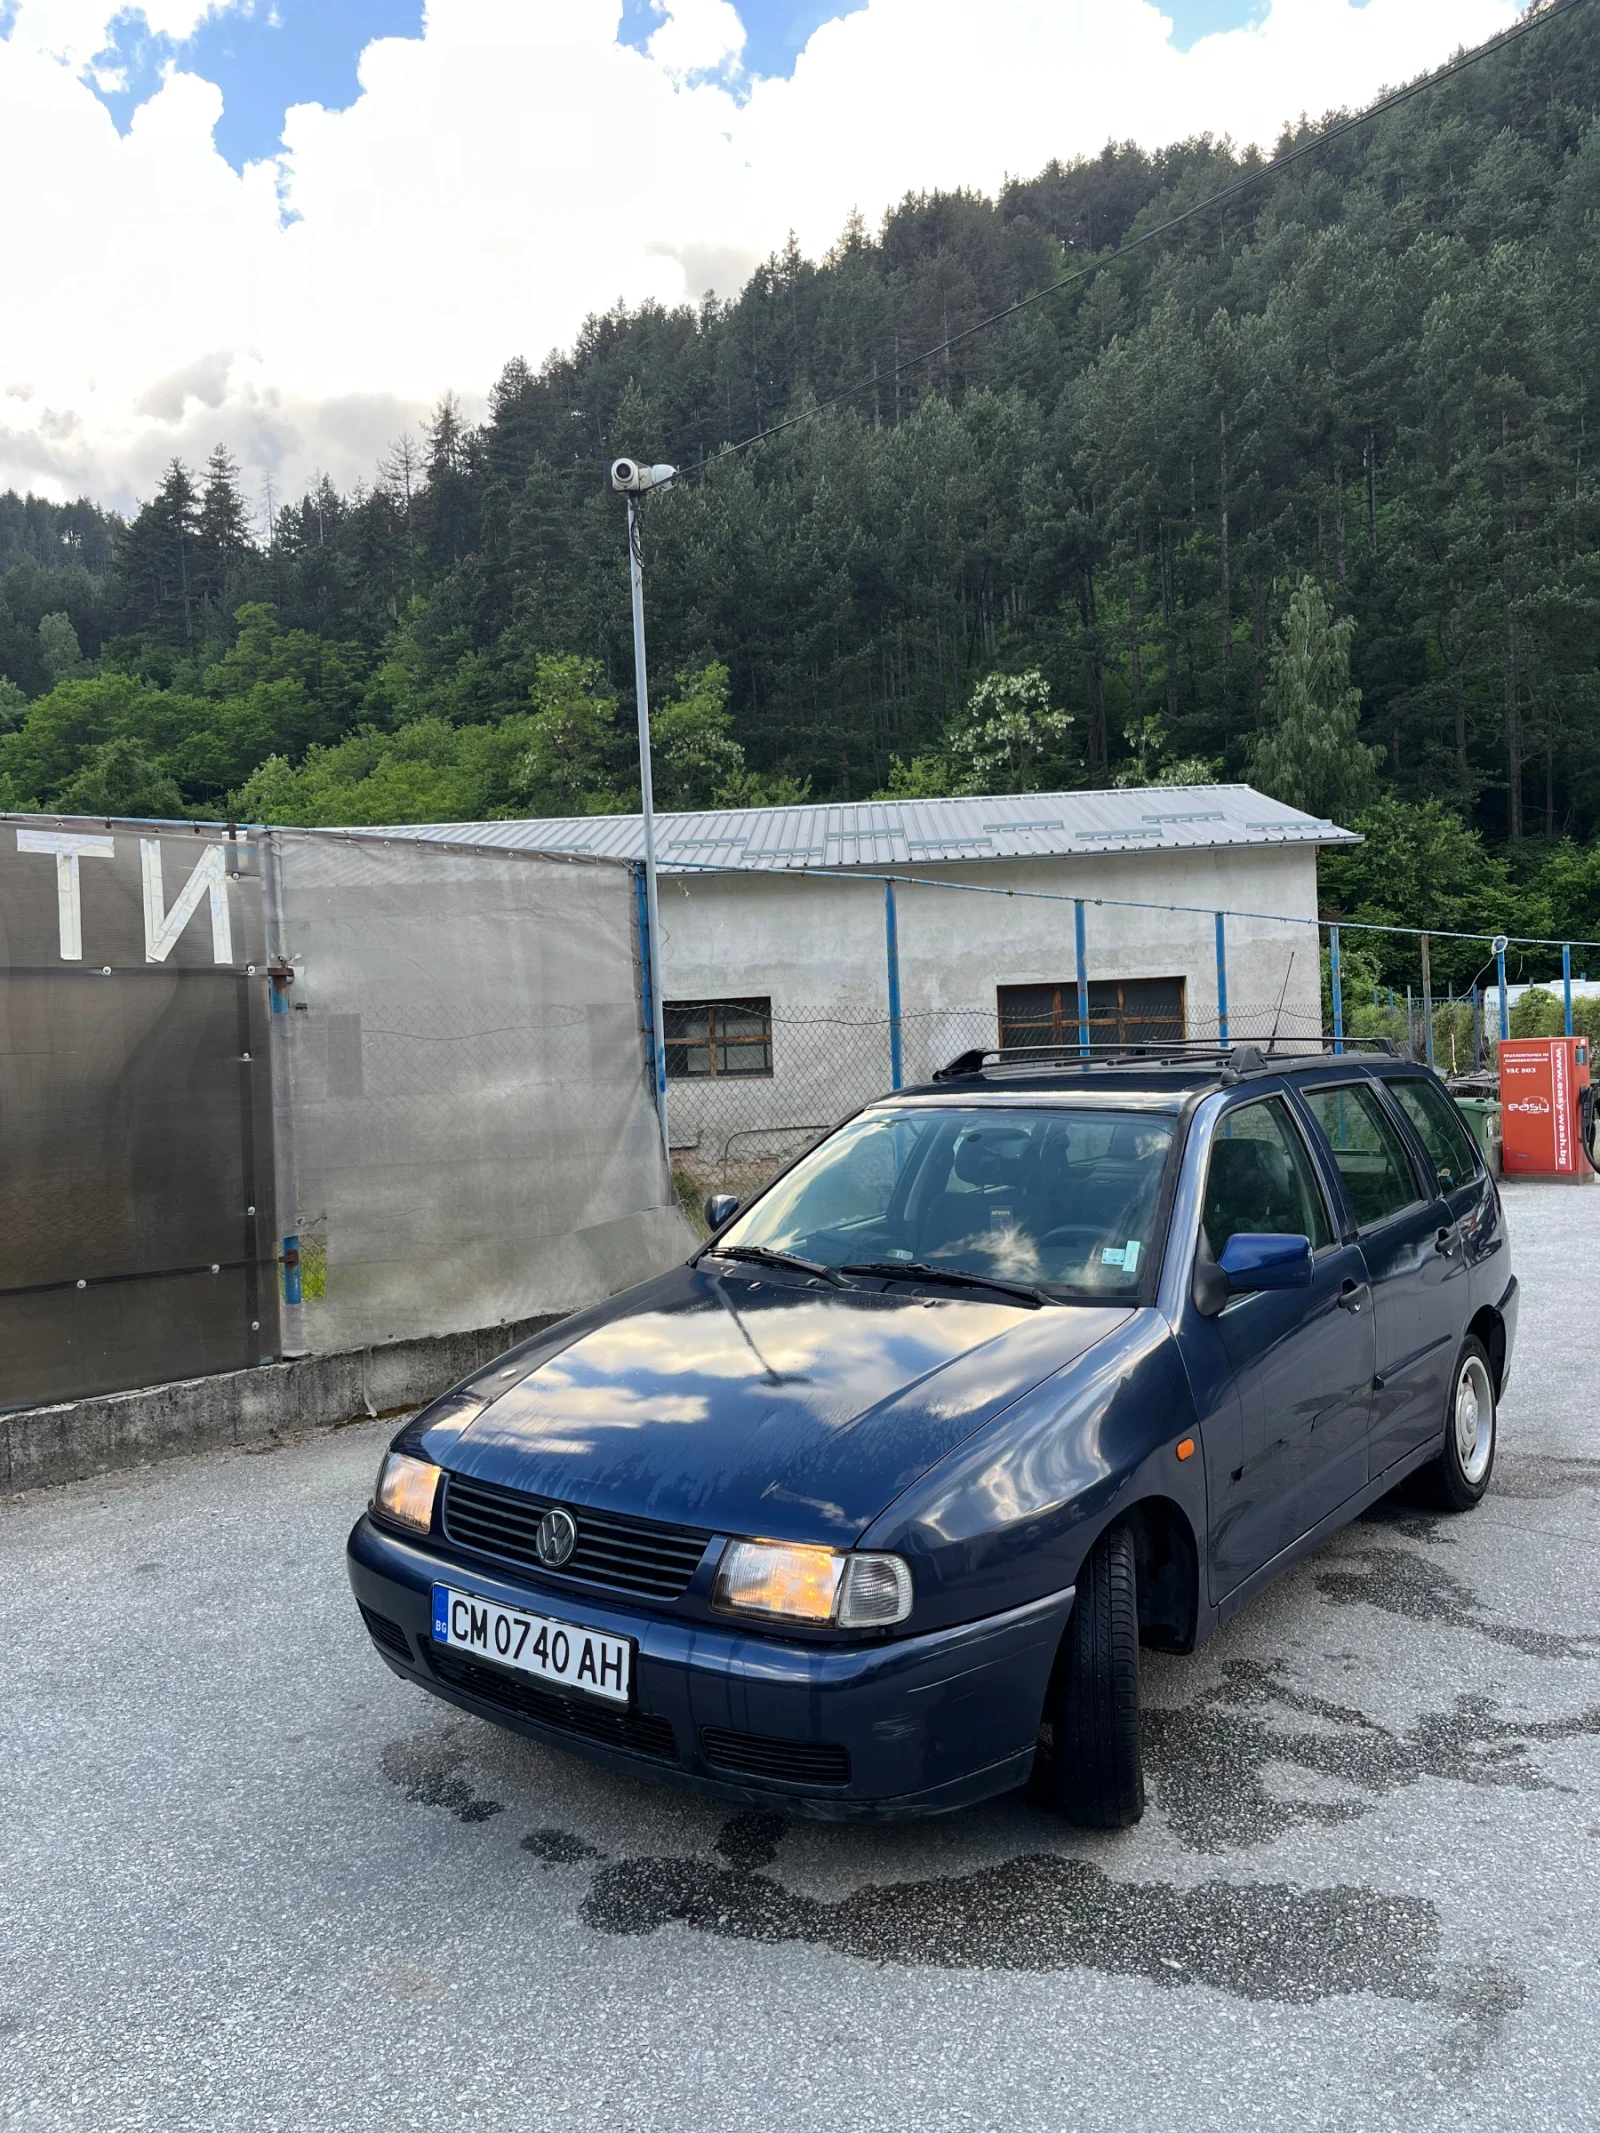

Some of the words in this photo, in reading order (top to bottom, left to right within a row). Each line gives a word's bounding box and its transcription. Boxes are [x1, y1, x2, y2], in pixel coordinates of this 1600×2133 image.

[1508, 1103, 1549, 1113] easy
[1555, 1048, 1567, 1165] www.easy-wash.bg
[435, 1619, 447, 1634] BG
[452, 1600, 488, 1649] CM
[495, 1614, 570, 1673] 0740
[577, 1637, 623, 1691] AH
